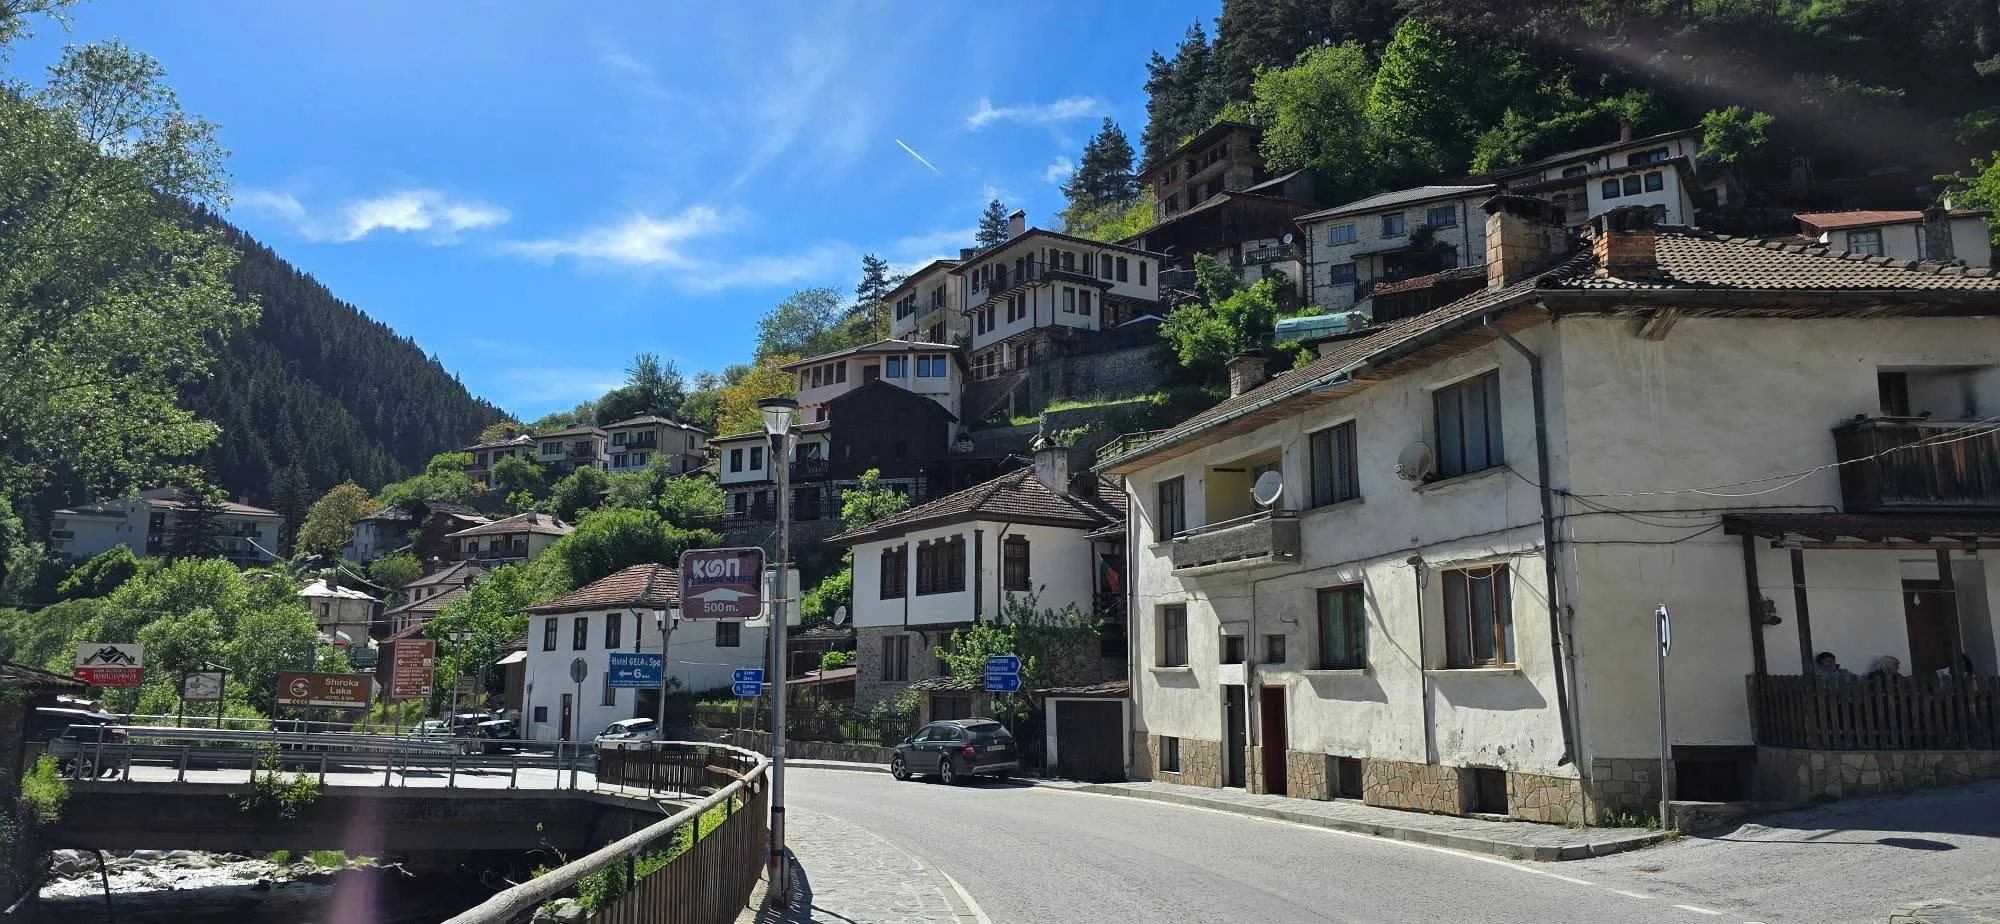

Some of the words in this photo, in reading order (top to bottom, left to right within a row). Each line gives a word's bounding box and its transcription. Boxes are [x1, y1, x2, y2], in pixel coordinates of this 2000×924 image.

[629, 657, 645, 666] GELA
[649, 657, 661, 669] Spa
[633, 668, 642, 678] 6
[324, 678, 359, 687] Shiroka
[330, 686, 352, 695] Laka
